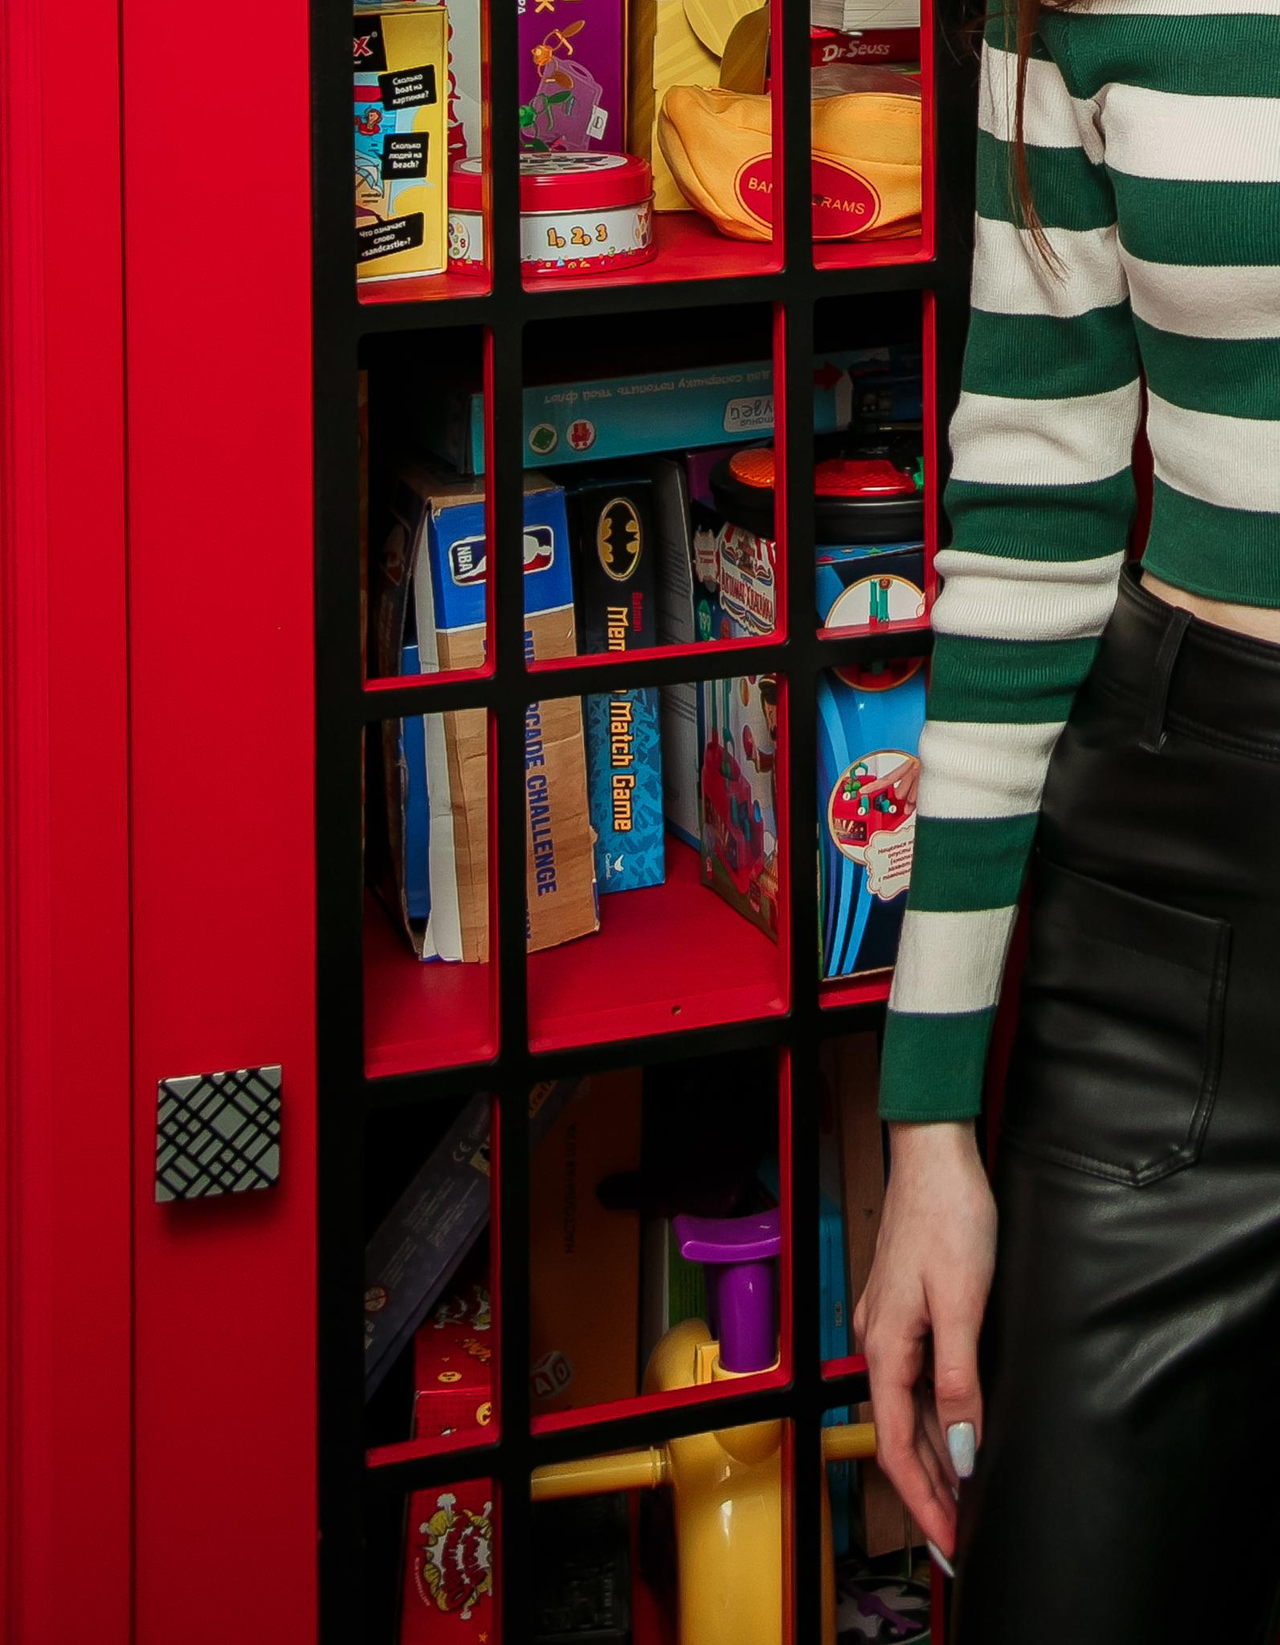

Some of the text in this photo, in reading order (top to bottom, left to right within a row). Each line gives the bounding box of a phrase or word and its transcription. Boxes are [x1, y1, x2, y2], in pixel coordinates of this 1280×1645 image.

[846, 40, 891, 58] Seuss
[392, 74, 423, 85] Сколько
[395, 85, 413, 95] boat
[392, 90, 429, 105] картинке?
[391, 141, 421, 150] Сколько
[389, 151, 412, 160] людей
[392, 160, 419, 169] beach?
[374, 221, 406, 234] означает
[373, 234, 395, 244] слово
[456, 545, 473, 573] NBA
[609, 700, 634, 767] Match
[612, 774, 636, 832] Game
[526, 774, 558, 897] CHALLENGE
